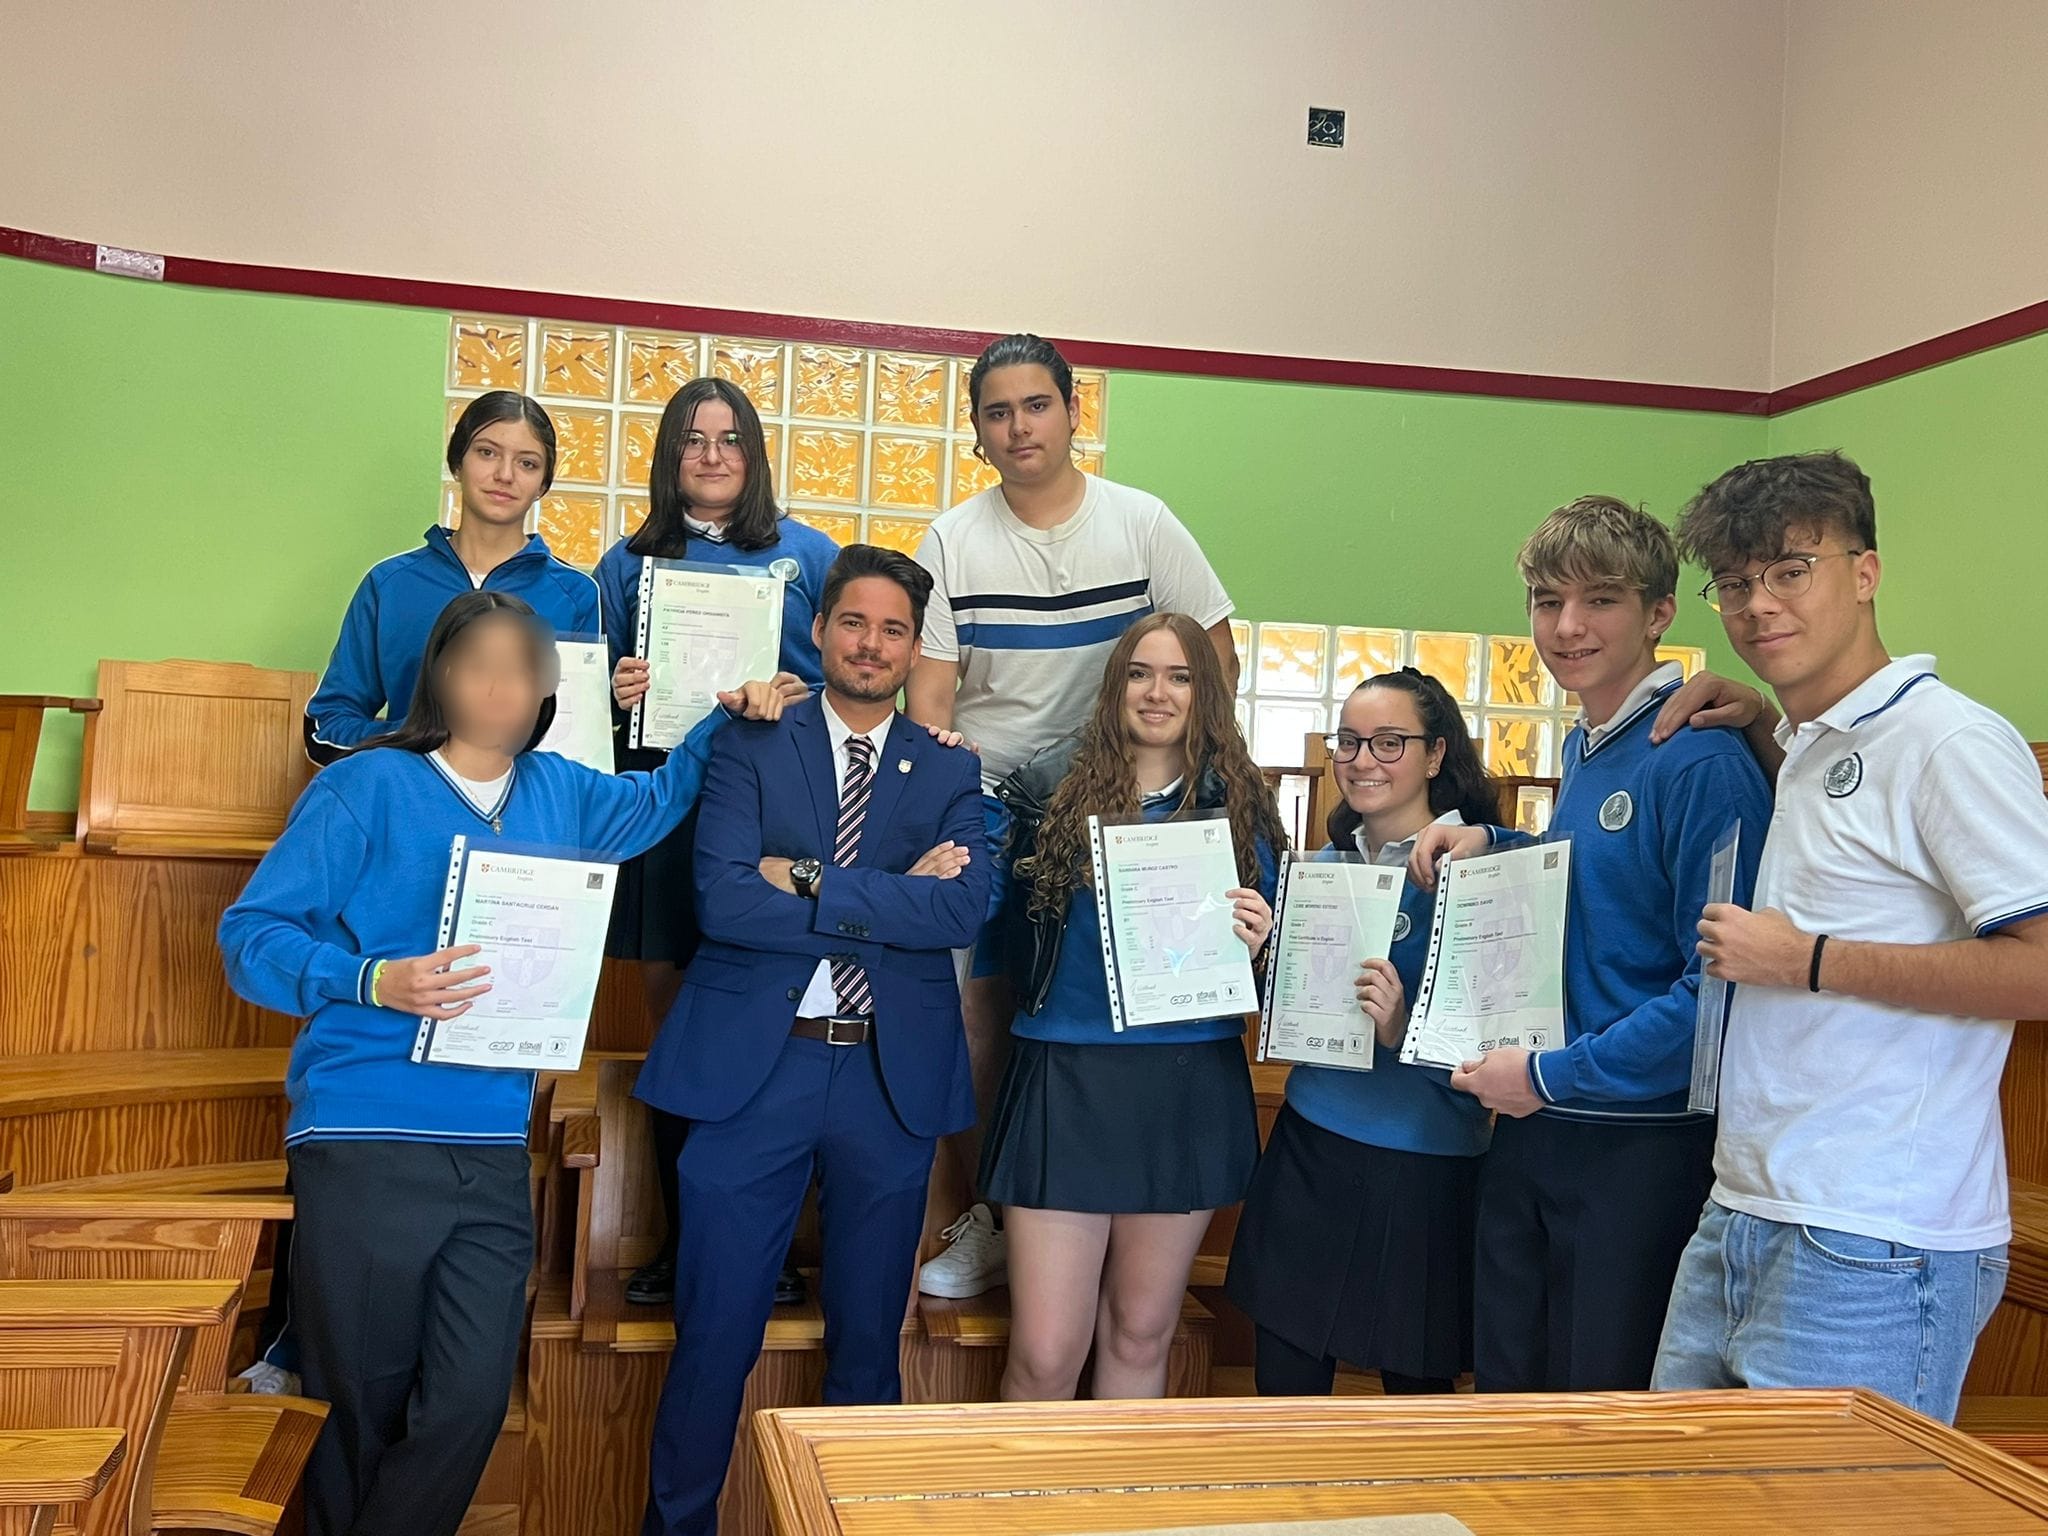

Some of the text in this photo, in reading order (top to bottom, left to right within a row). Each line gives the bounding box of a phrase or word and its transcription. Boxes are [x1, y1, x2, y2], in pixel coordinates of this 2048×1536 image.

[490, 866, 534, 876] CAMBRIDGE
[1468, 865, 1501, 876] CAMBRIDGE
[475, 898, 500, 906] MARTINA
